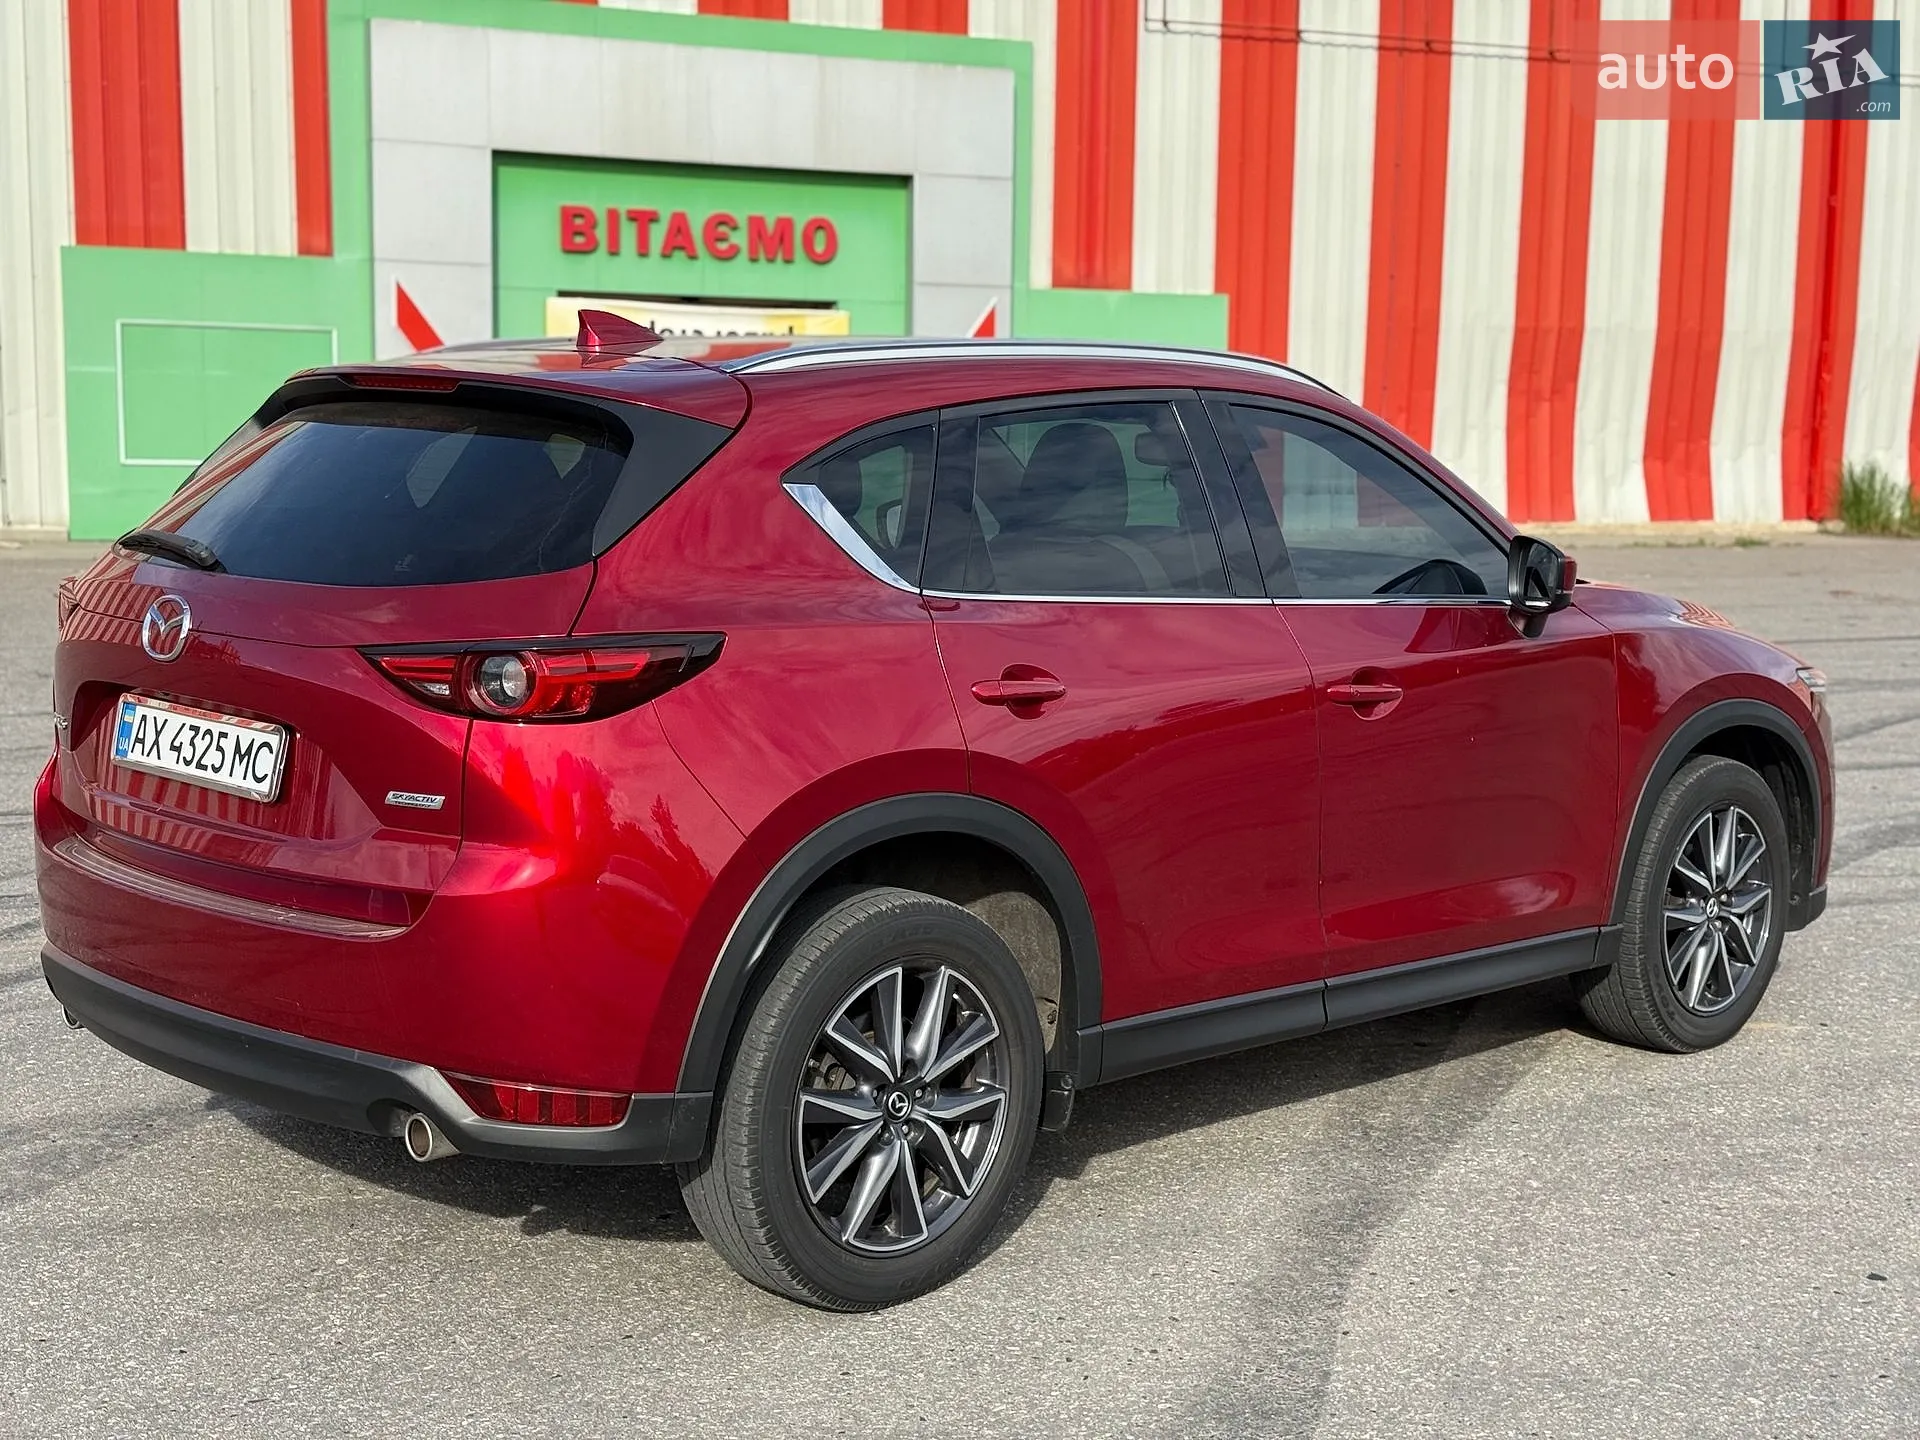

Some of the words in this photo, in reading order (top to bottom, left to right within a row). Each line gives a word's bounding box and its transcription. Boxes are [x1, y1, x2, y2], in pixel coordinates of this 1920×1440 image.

[560, 204, 839, 264] ВІТАЄМО
[118, 736, 129, 751] UA
[131, 714, 168, 761] AX
[169, 722, 229, 774] 4325
[229, 734, 274, 784] MC
[391, 792, 438, 804] SKYACTIV
